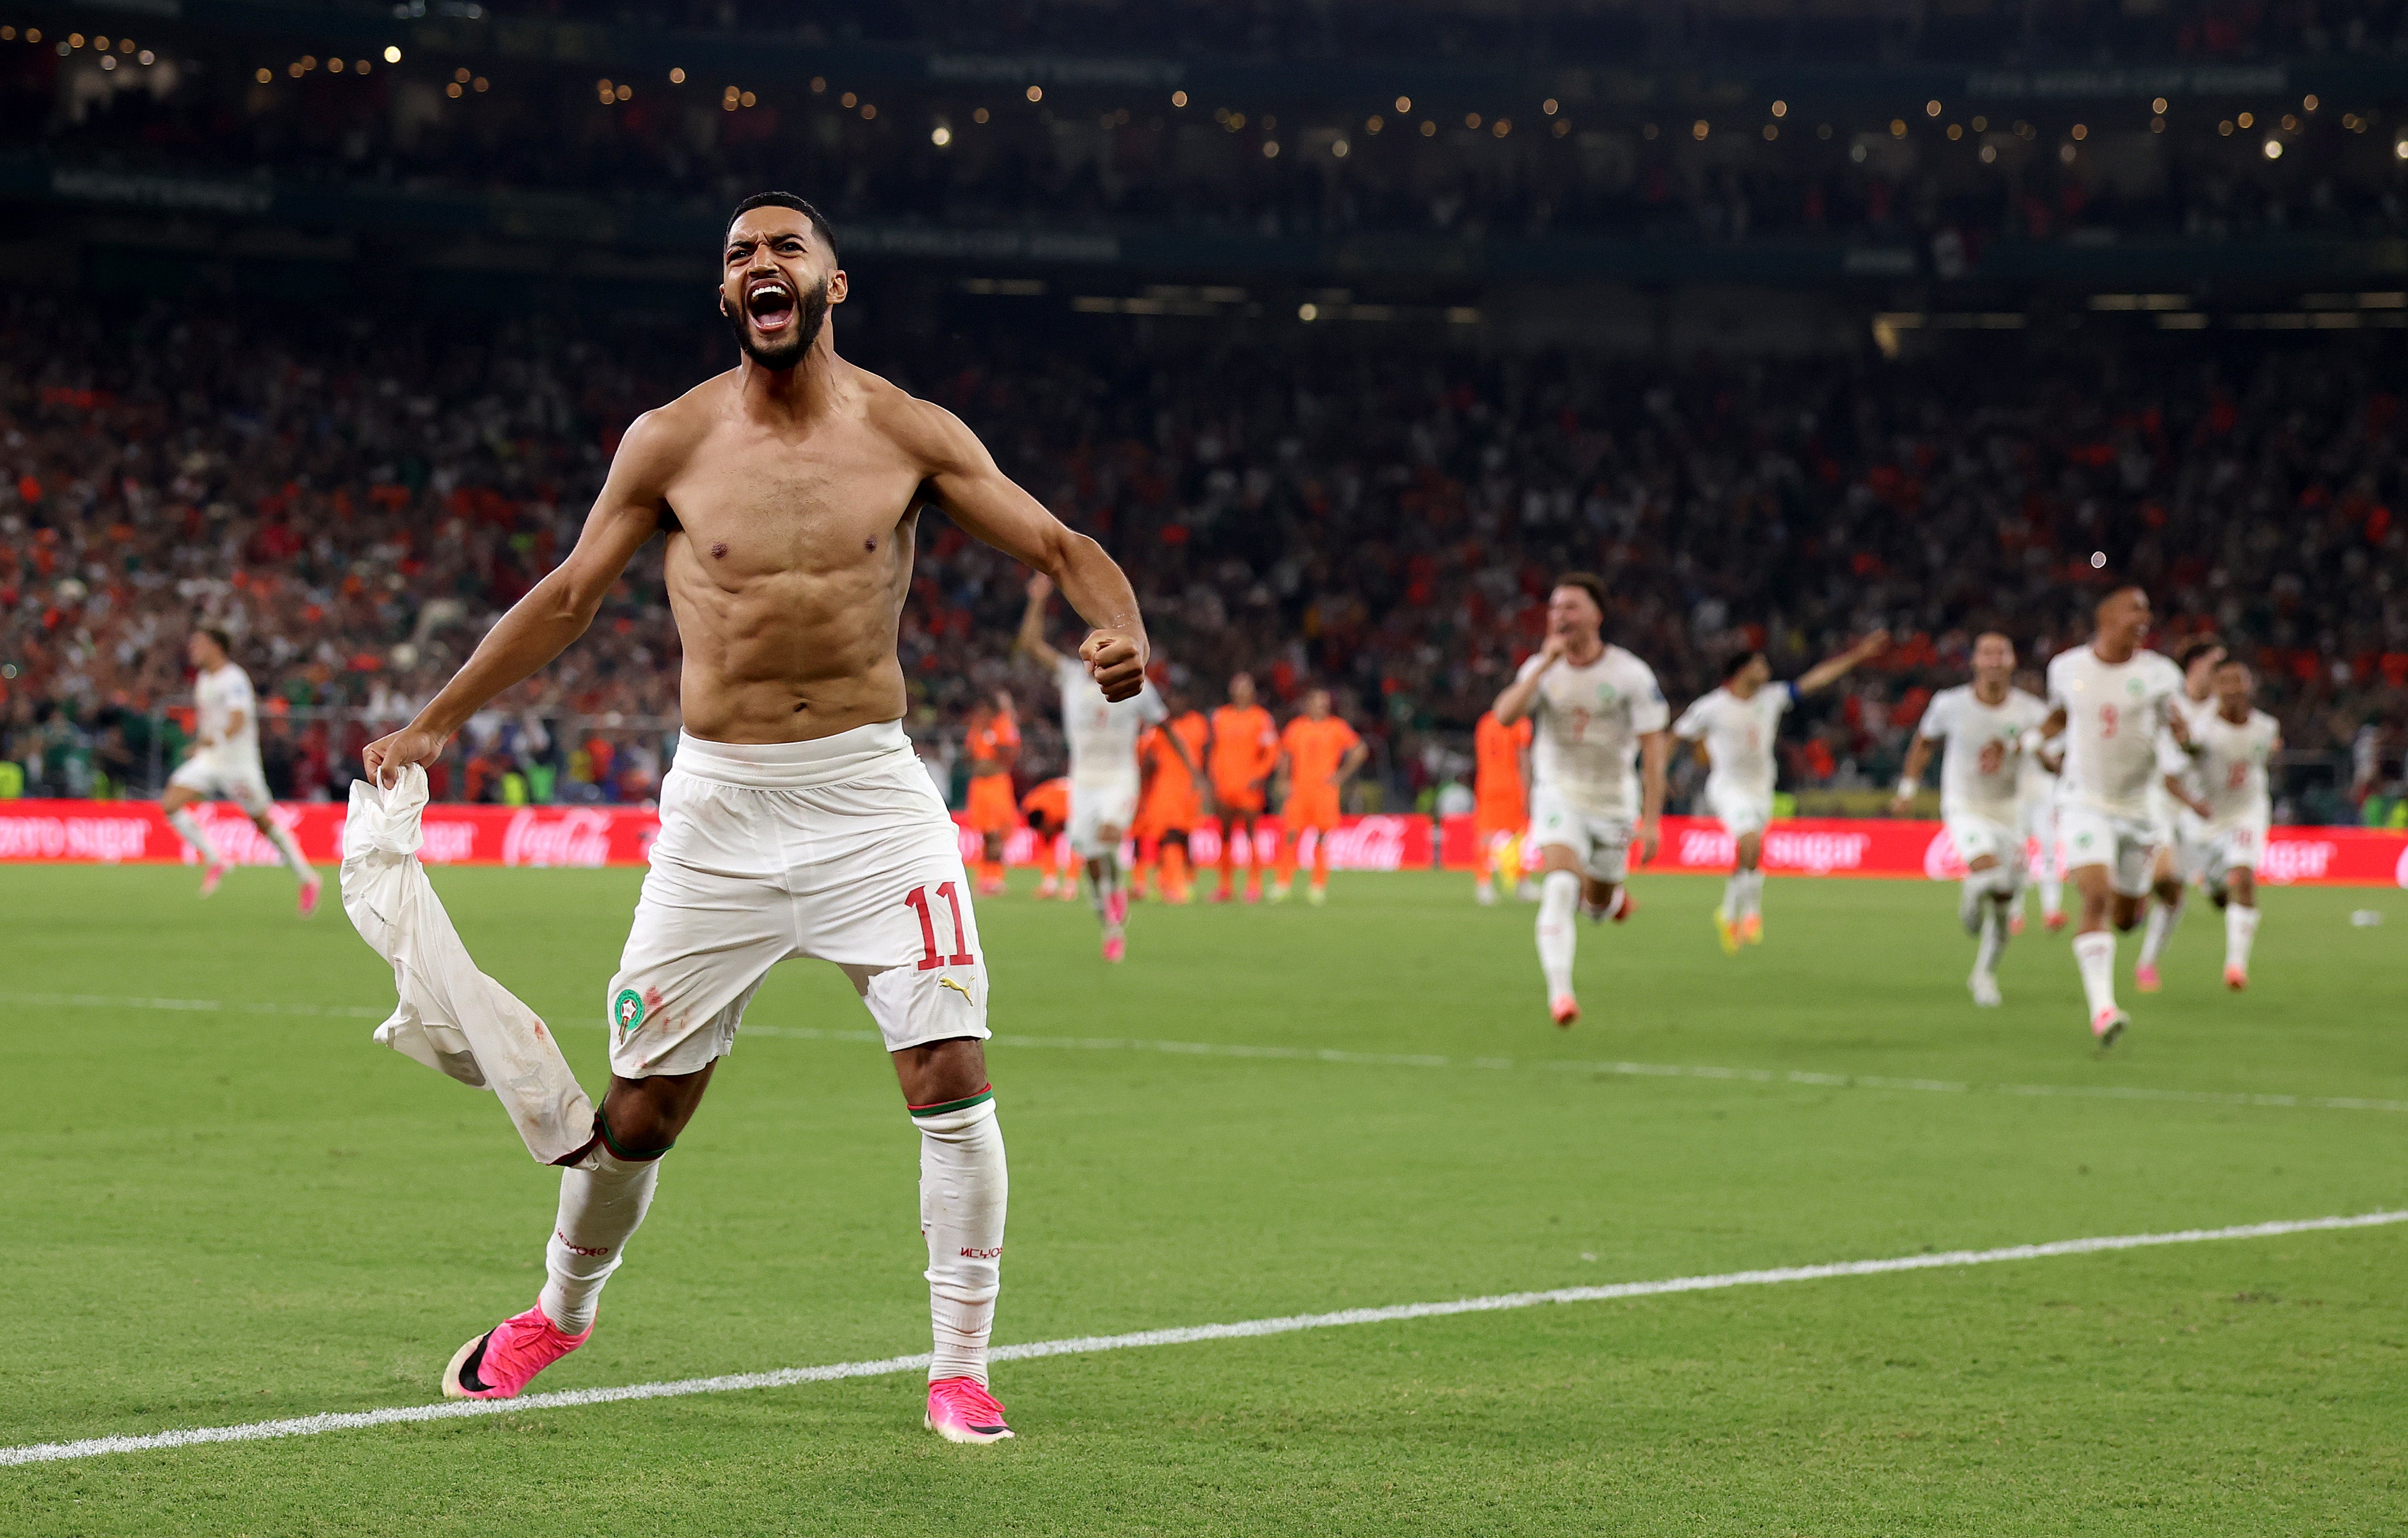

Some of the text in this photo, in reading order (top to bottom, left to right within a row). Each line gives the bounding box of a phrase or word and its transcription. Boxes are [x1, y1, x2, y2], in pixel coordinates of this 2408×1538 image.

[65, 816, 152, 865] sugar
[1763, 831, 1871, 876] sugar
[904, 881, 974, 971] 11
